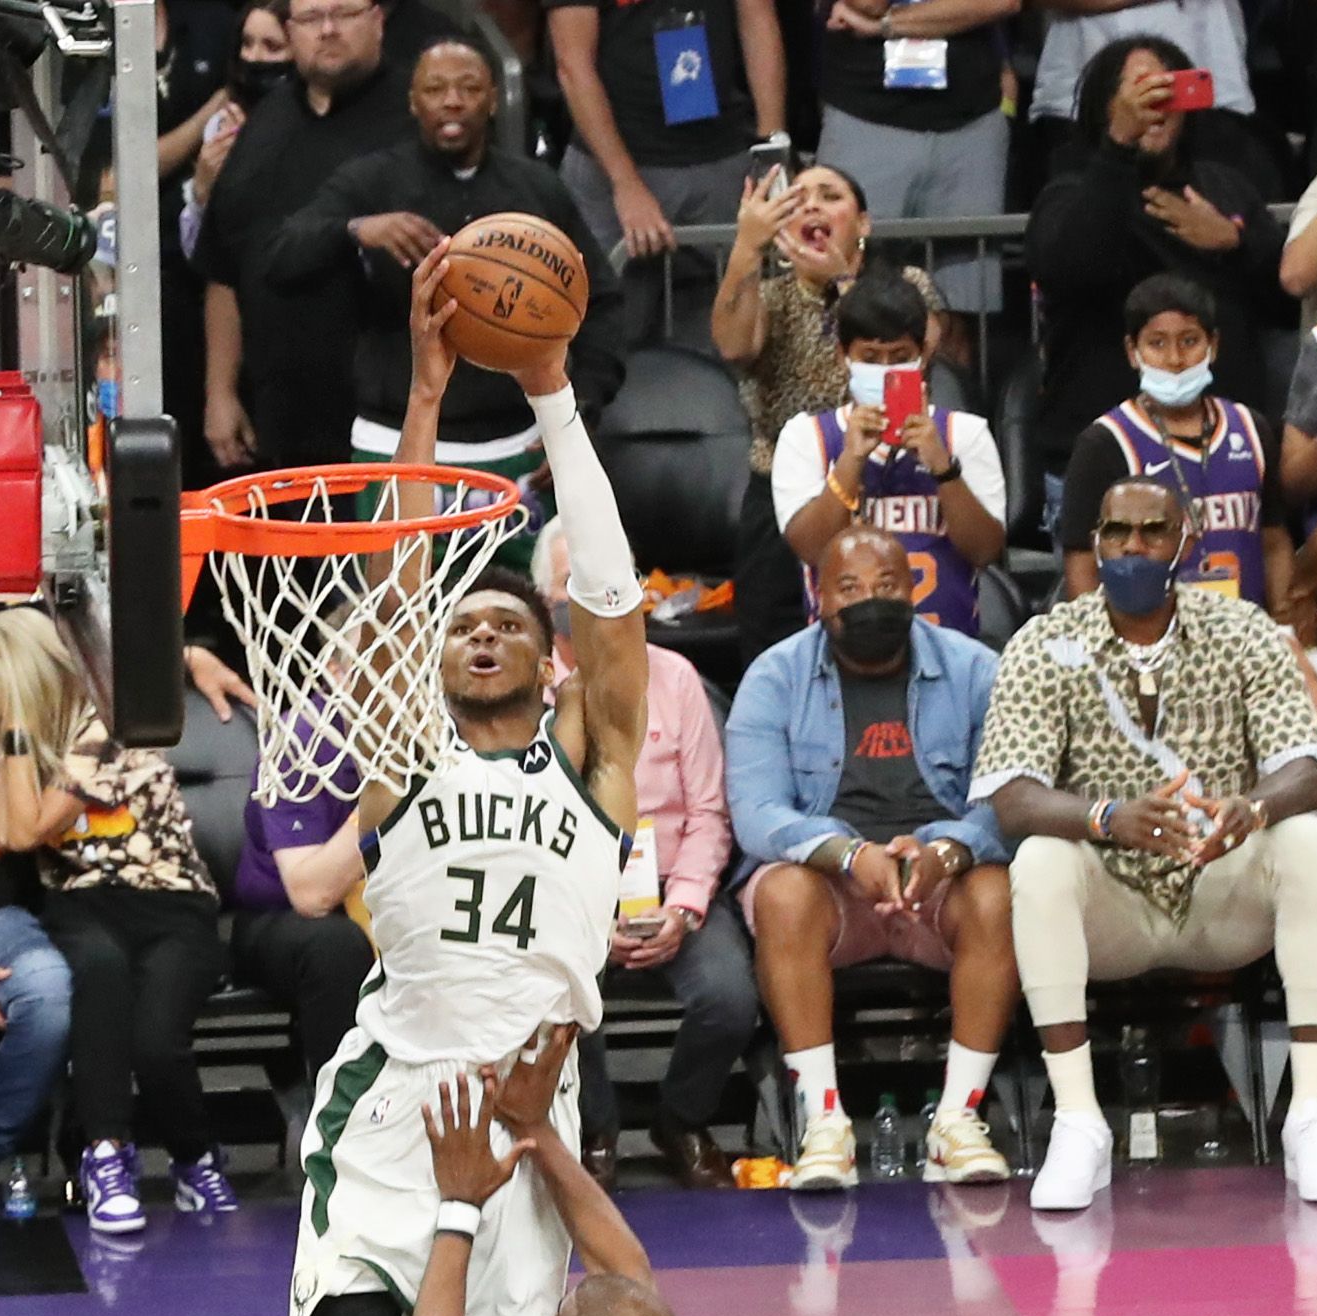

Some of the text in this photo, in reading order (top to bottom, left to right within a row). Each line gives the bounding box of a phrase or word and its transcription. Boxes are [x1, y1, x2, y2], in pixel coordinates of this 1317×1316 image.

[472, 229, 576, 289] SPALDING
[418, 793, 577, 860] BUCKS
[440, 866, 537, 950] 34
